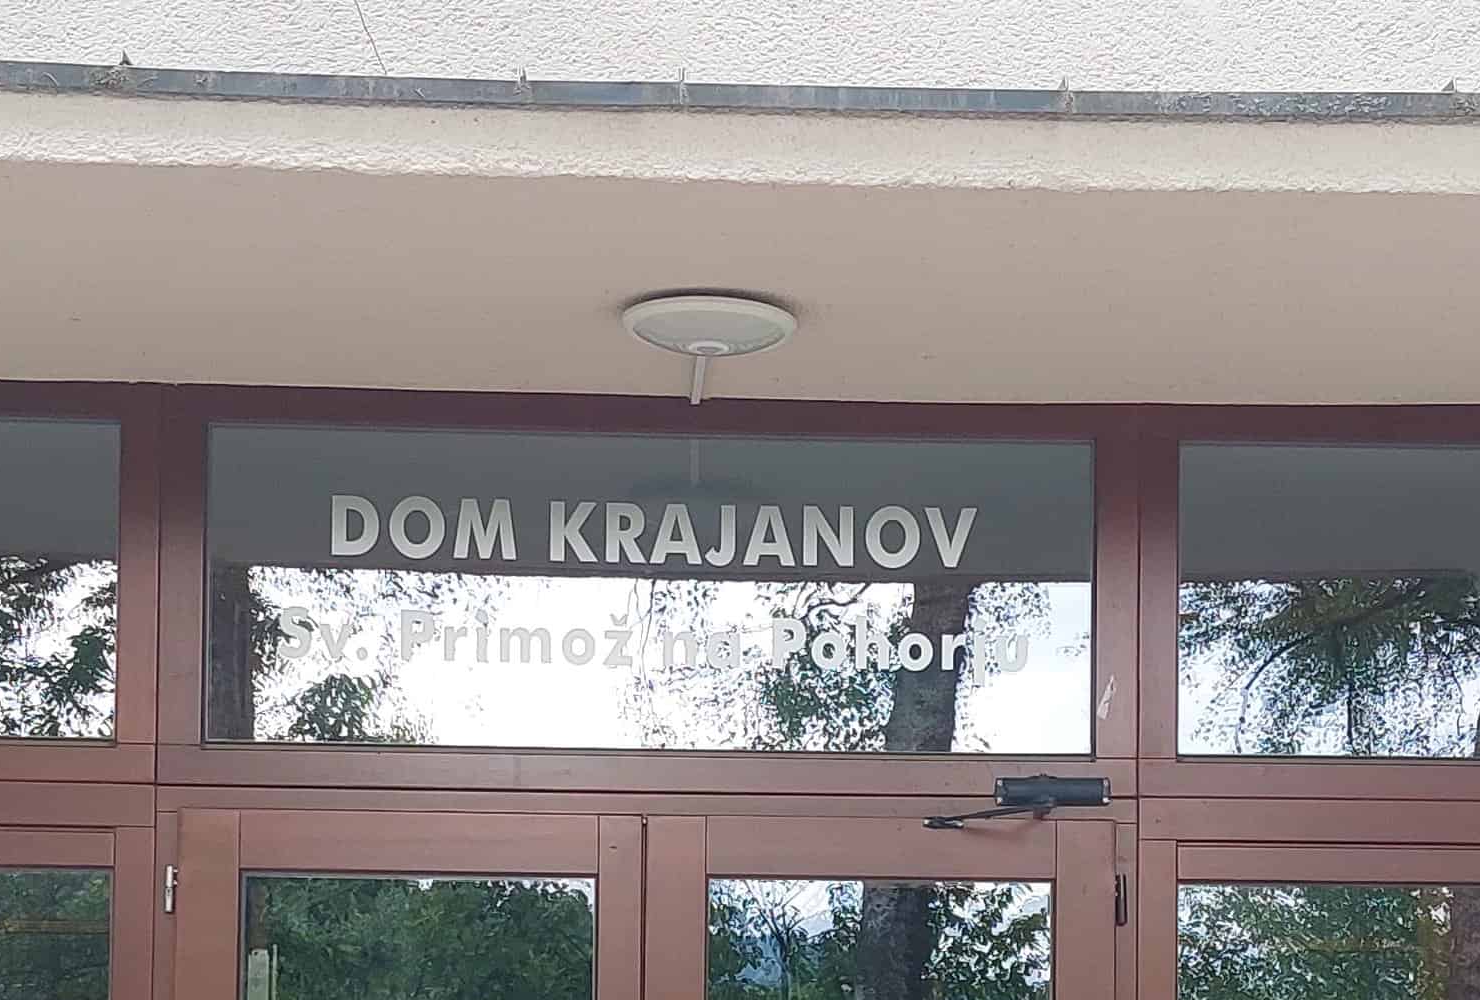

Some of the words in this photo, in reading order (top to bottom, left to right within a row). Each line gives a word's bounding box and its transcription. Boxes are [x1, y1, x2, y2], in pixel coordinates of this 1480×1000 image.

[330, 494, 517, 562] DOM
[549, 501, 978, 568] KRAJANOV
[279, 606, 368, 660] Sv.
[400, 609, 634, 666] Primož
[662, 631, 741, 669] na
[771, 615, 1029, 687] Pohorju
